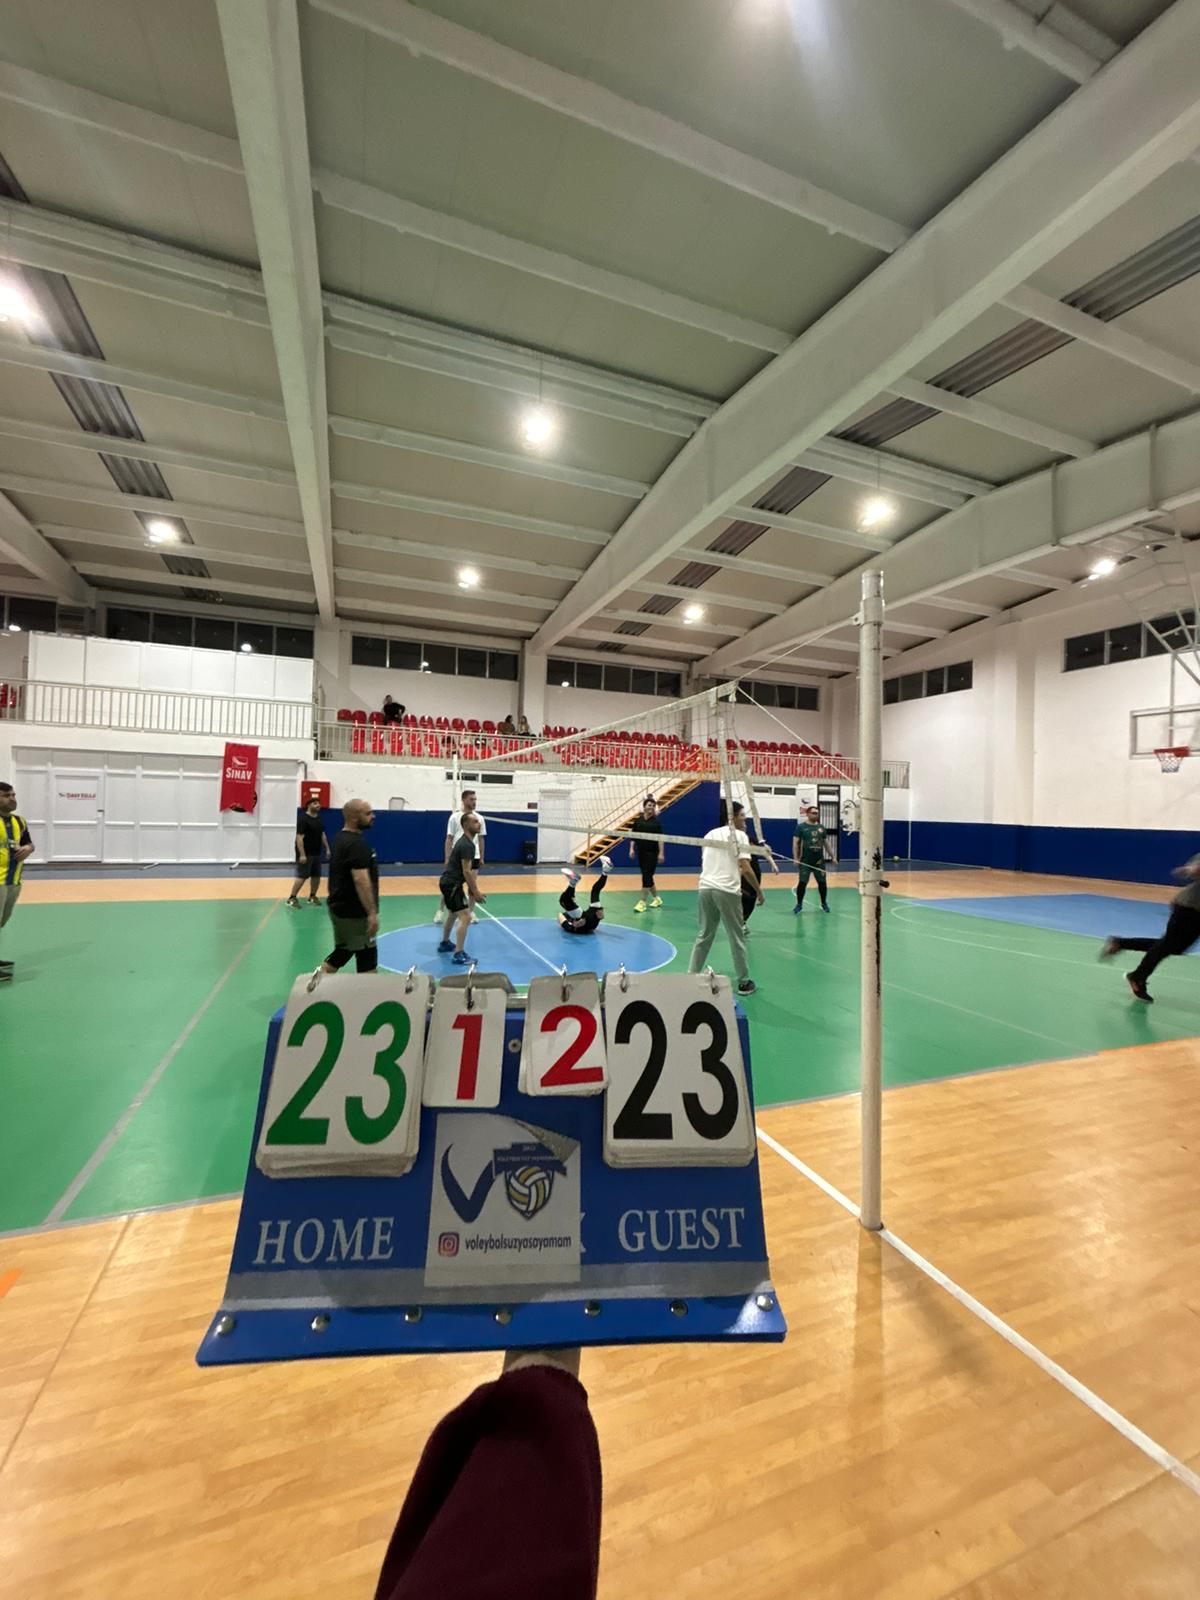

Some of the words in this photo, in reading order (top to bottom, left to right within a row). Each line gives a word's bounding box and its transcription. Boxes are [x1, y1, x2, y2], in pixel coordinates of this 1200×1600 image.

[265, 1000, 411, 1146] 23
[452, 1014, 483, 1101] 1
[540, 1004, 604, 1088] 2
[613, 1000, 739, 1140] 23
[252, 1216, 395, 1265] HOME
[618, 1207, 745, 1253] GUEST
